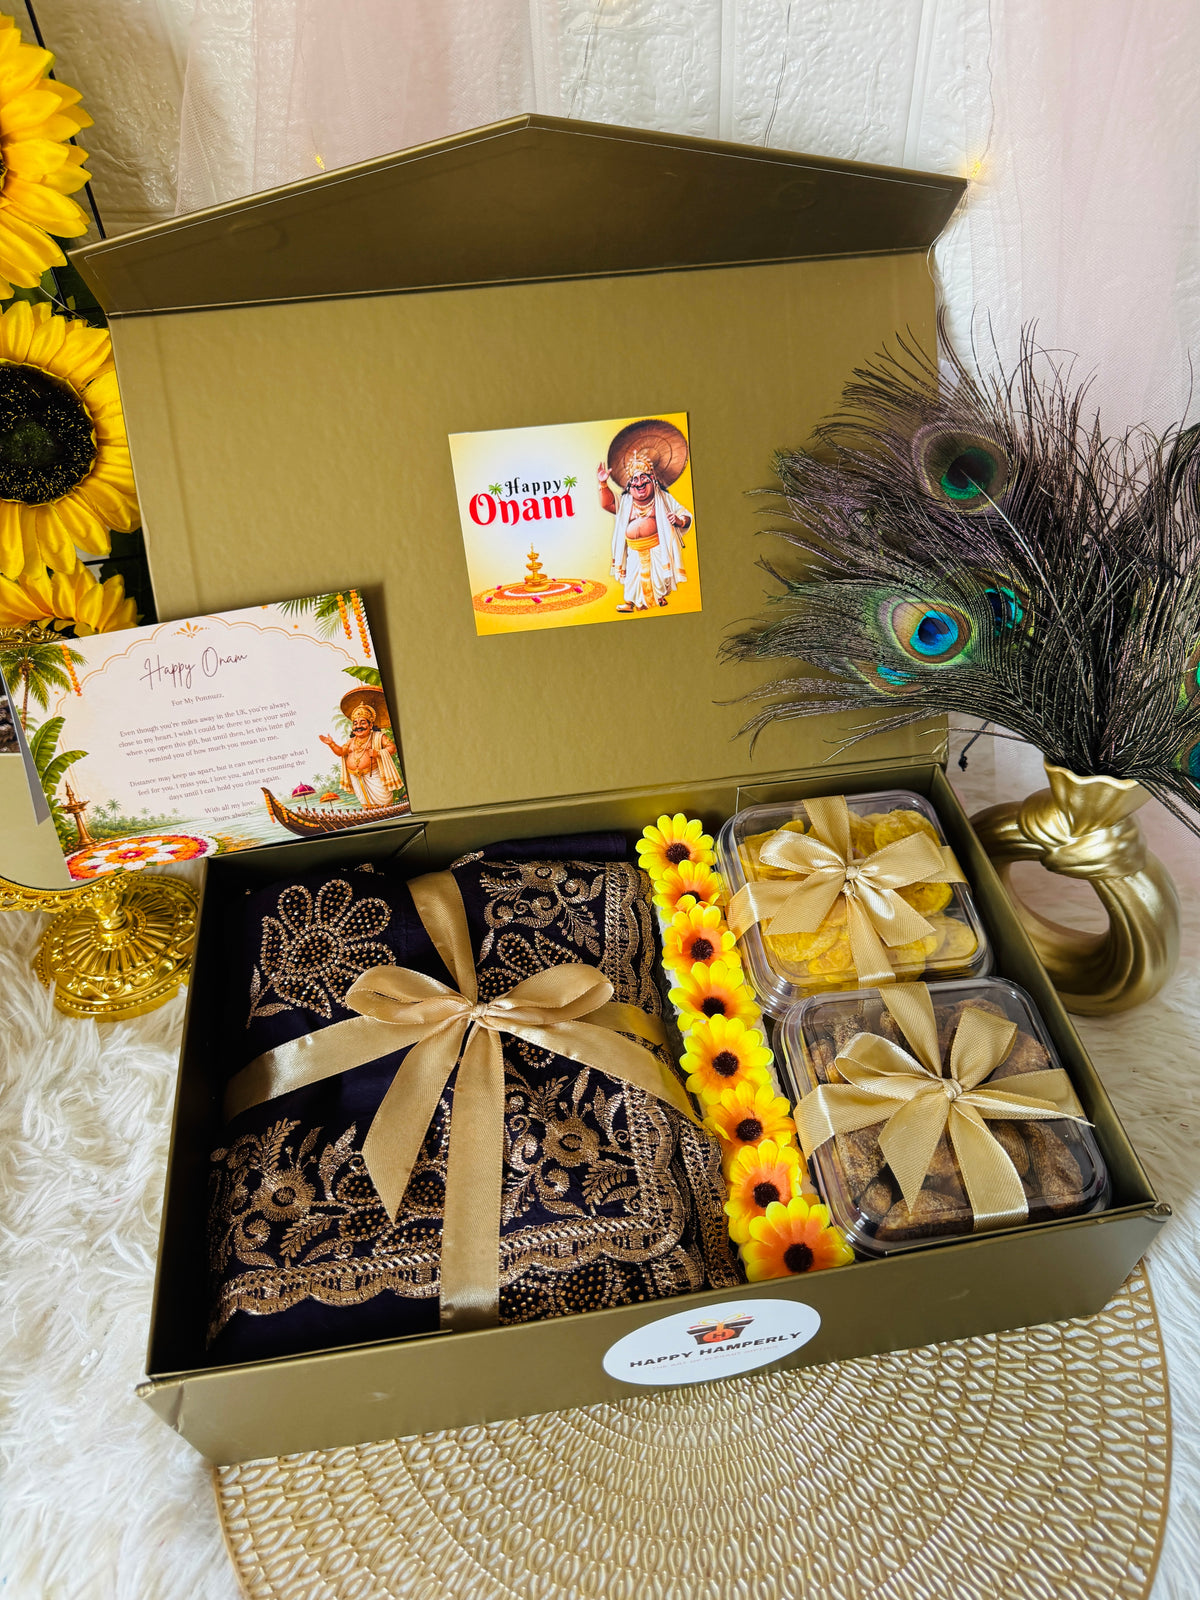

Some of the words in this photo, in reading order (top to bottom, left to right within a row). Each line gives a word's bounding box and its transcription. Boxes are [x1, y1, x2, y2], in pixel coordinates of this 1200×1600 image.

[505, 477, 561, 497] Happy
[469, 493, 575, 526] Onam
[140, 654, 195, 690] Happy
[202, 647, 248, 677] Onam
[136, 725, 158, 733] though
[159, 722, 180, 730] you're
[248, 705, 267, 714] you're
[198, 724, 216, 732] could
[212, 732, 227, 740] until
[284, 720, 295, 728] gift
[148, 754, 171, 763] remind
[226, 742, 238, 750] you
[129, 779, 156, 787] Distance
[266, 753, 288, 761] change
[266, 762, 295, 771] counting
[183, 789, 199, 797] until
[216, 783, 230, 791] hold
[629, 1351, 693, 1368] HAPPY
[700, 1331, 801, 1356] HAMPERLY
